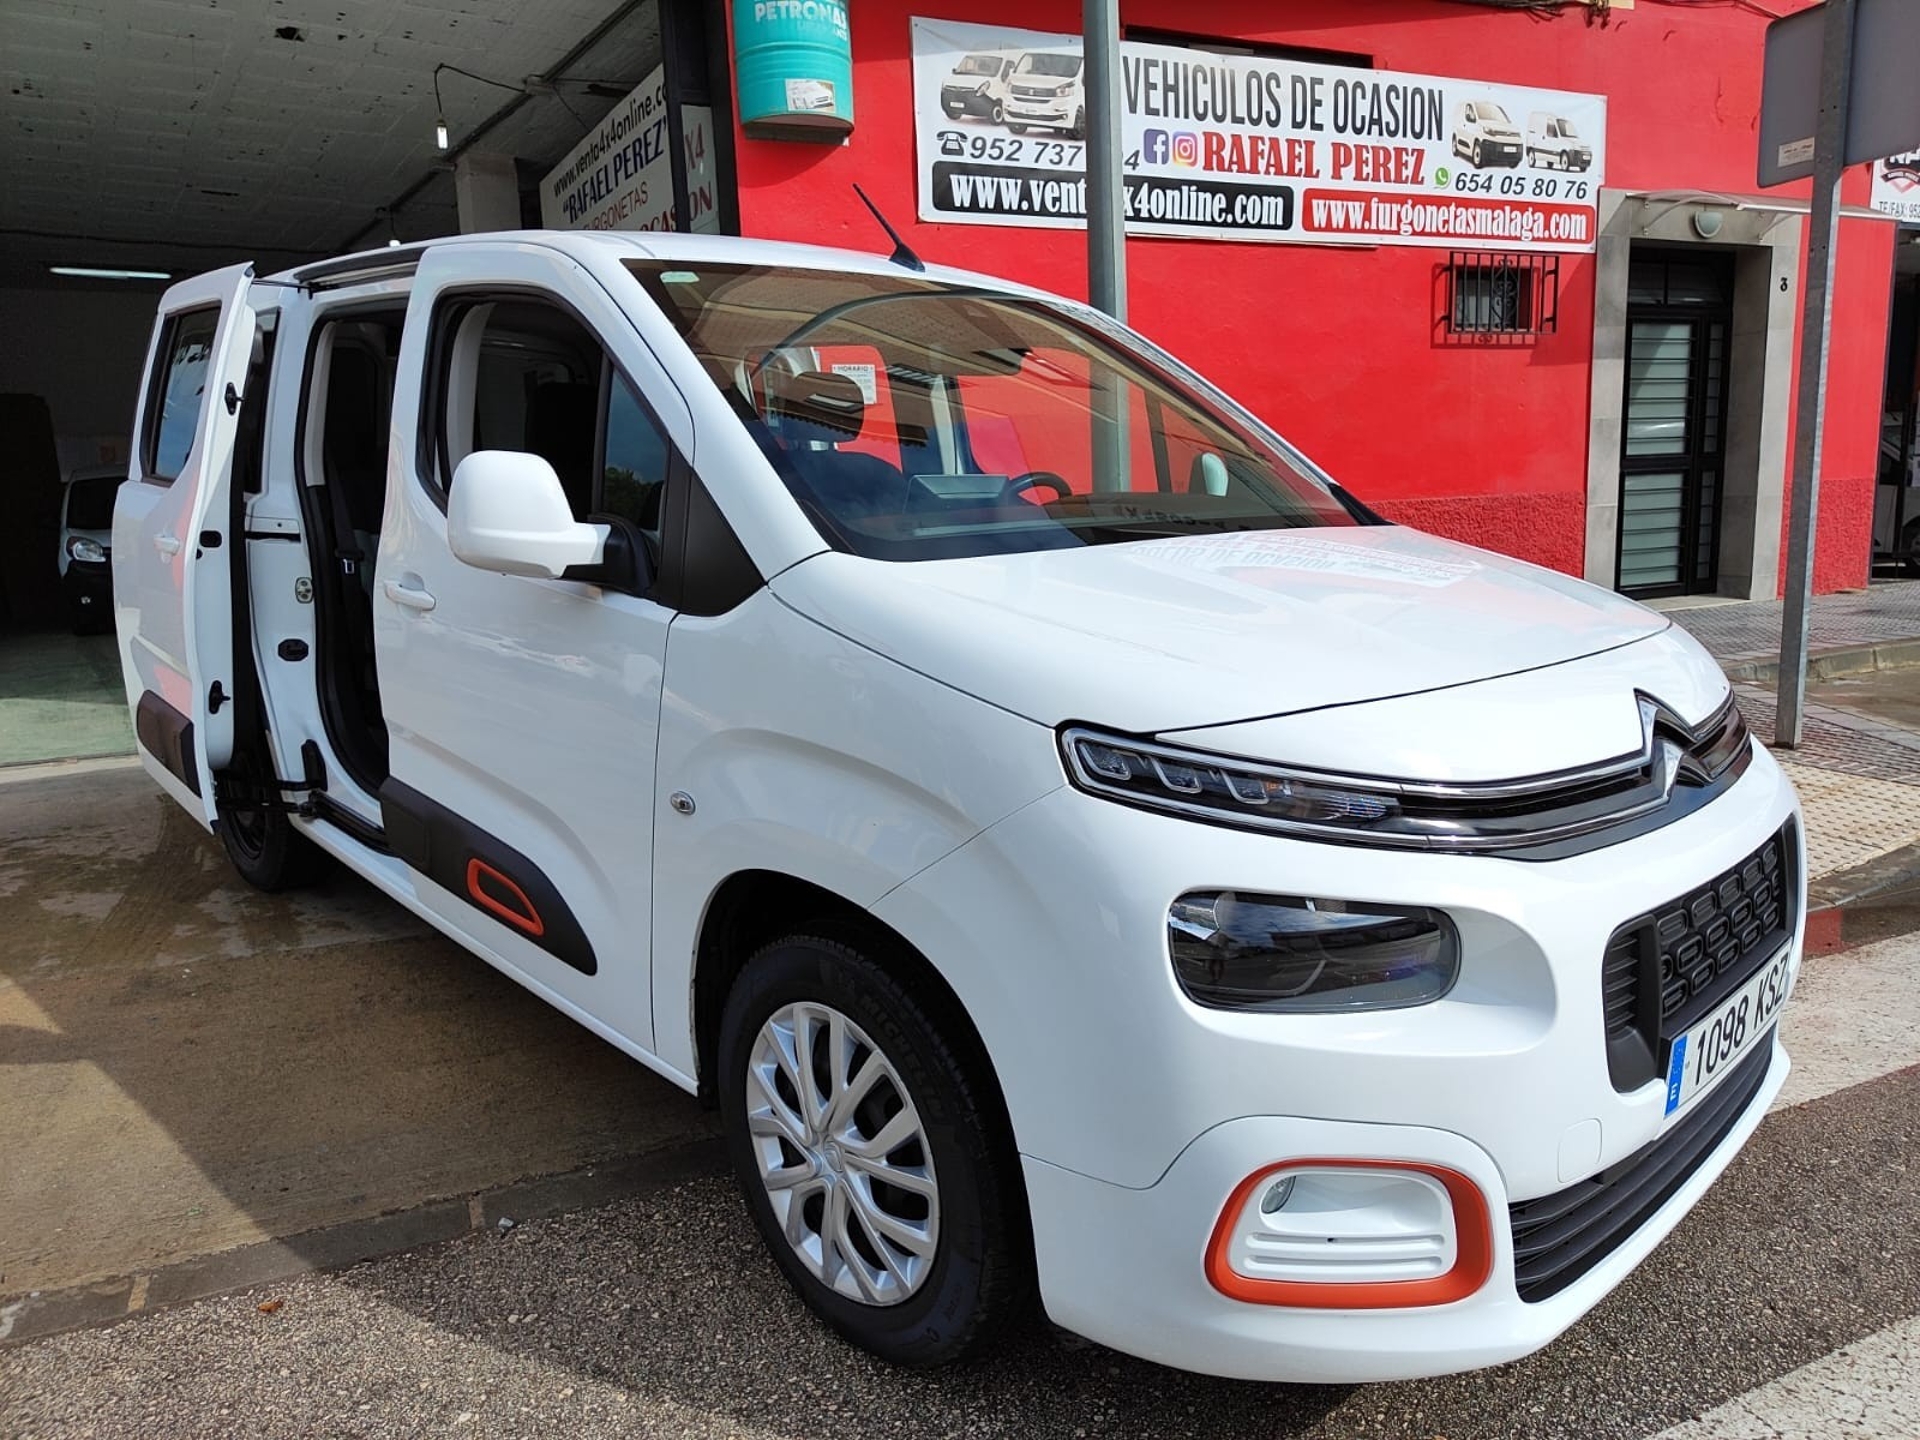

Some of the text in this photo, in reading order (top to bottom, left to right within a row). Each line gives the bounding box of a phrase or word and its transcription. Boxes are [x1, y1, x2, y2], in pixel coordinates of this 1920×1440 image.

[1122, 55, 1444, 141] VEHICULOS DE OCASION
[553, 82, 667, 199] www.venta4x4online.co
[969, 135, 1023, 163] 952
[1034, 141, 1083, 167] 737
[1203, 130, 1321, 179] RAFAEL
[1331, 141, 1425, 186] PEREZ
[950, 173, 1588, 242] www.ventx4online.com www.furgonetasmalaga.com
[1455, 172, 1588, 200] 654 05 80 76
[1780, 277, 1788, 292] 3
[1695, 951, 1789, 1086] 1098 KSZ
